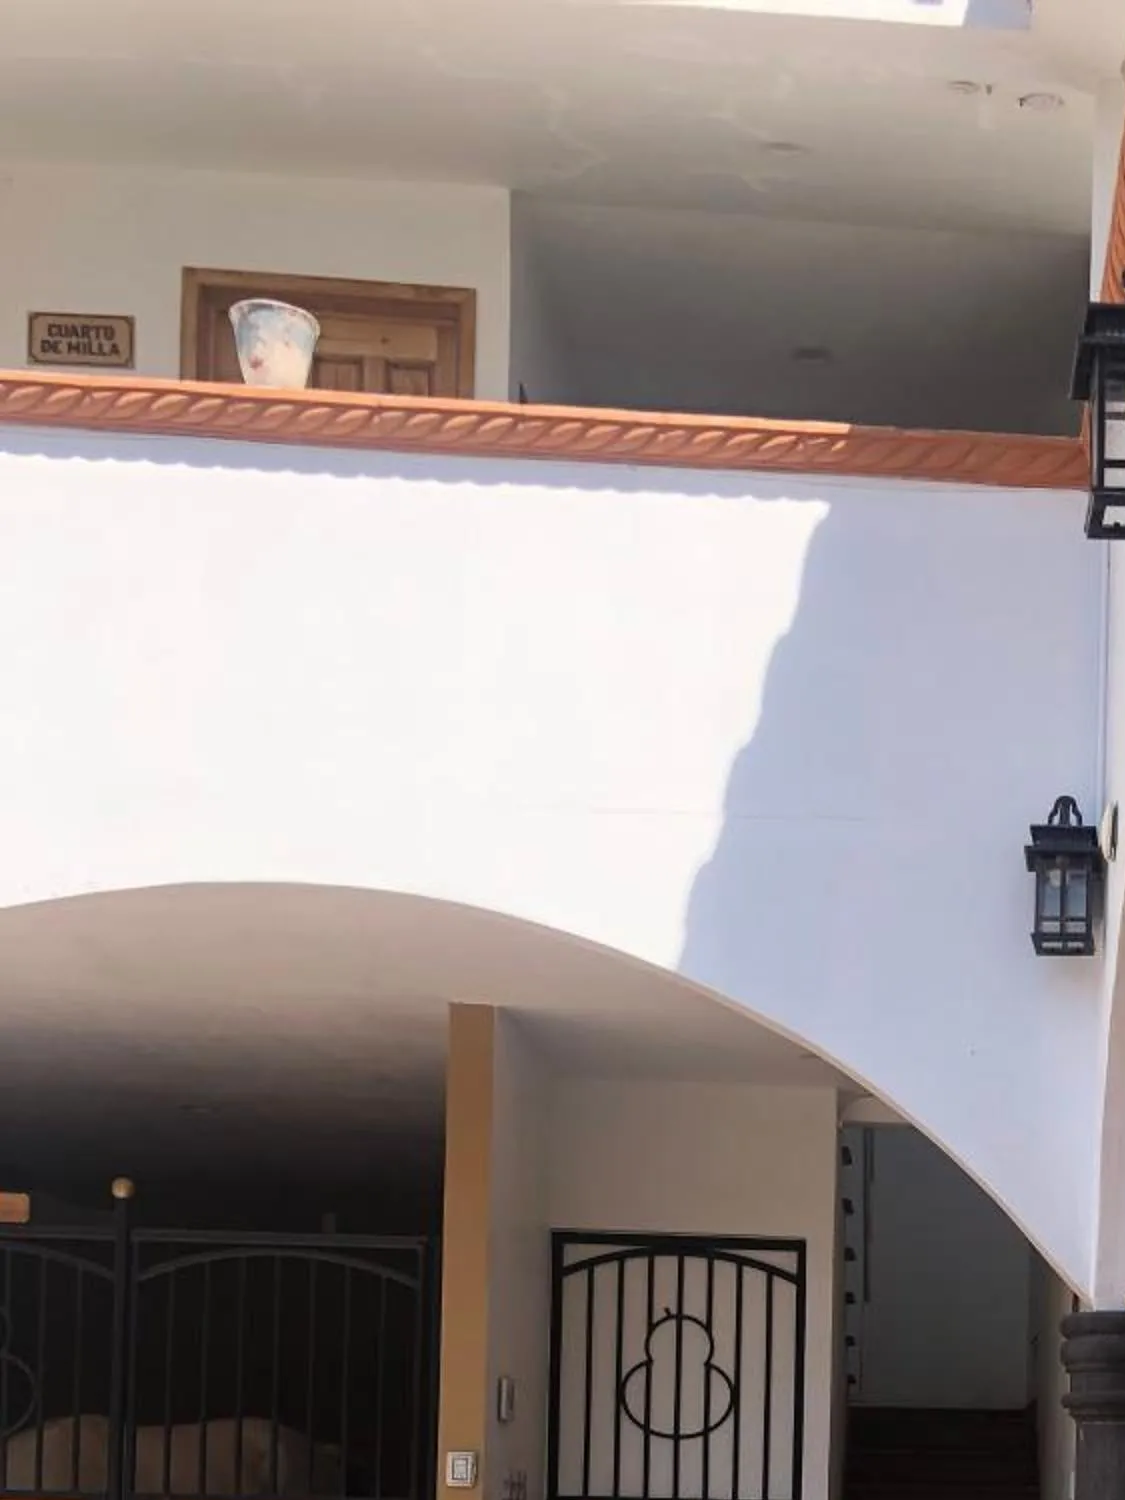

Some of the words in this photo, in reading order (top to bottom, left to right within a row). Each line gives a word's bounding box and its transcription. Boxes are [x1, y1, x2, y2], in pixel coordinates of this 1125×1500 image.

[47, 323, 117, 341] CUARTO
[40, 339, 63, 354] DE
[67, 340, 121, 356] MILLA
